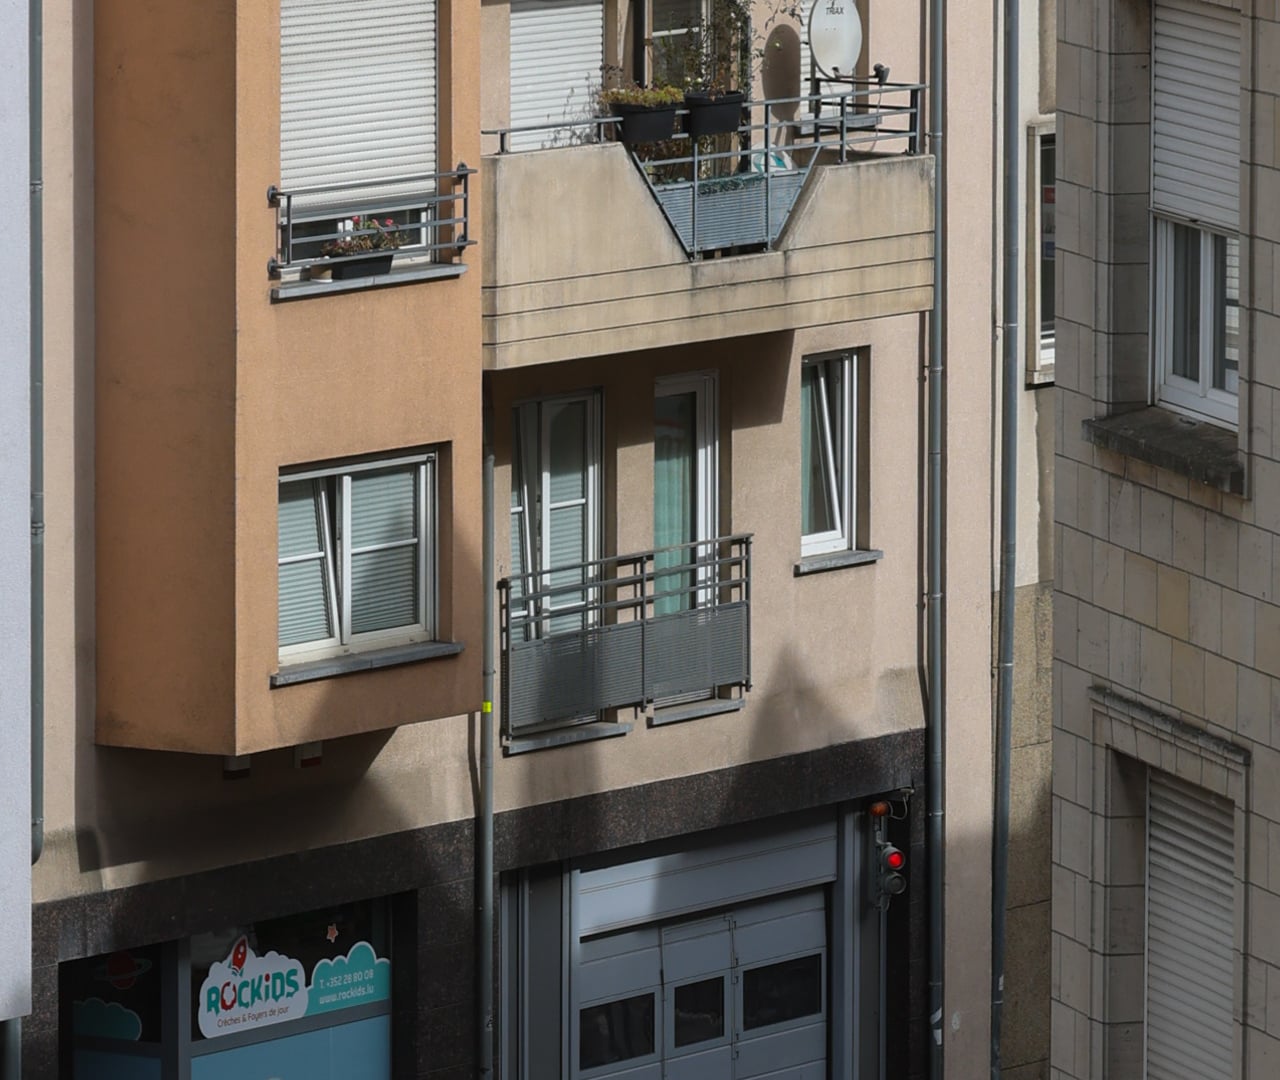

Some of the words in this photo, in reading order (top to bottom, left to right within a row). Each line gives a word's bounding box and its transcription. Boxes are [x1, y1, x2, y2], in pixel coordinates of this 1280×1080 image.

[320, 984, 374, 1004] www.rockids.lu
[248, 1010, 268, 1024] Foyers
[269, 1008, 276, 1017] de
